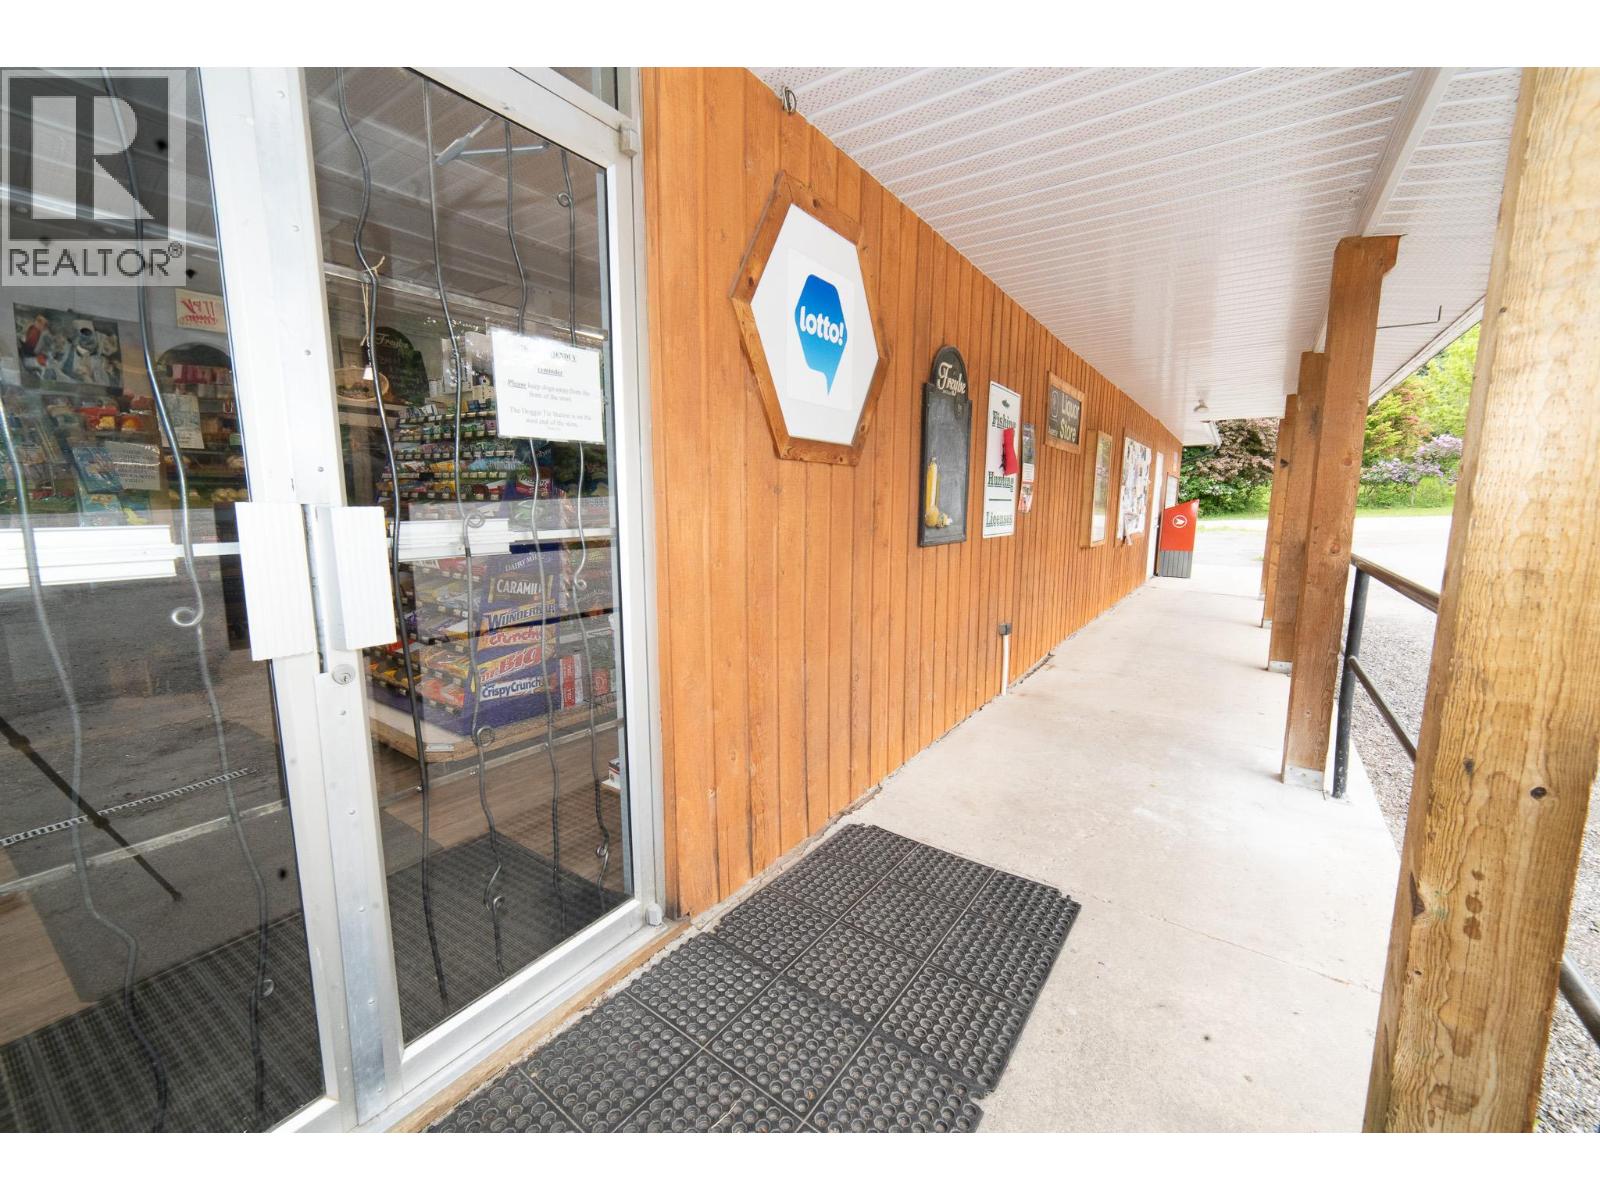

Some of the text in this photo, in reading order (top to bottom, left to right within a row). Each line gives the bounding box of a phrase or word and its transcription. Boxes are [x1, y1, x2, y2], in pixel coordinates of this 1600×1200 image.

[799, 305, 845, 346] lotto!
[937, 361, 967, 396] Freybe
[1060, 418, 1077, 443] Store
[988, 471, 1014, 492] Hunting
[986, 512, 1013, 527] Licenses
